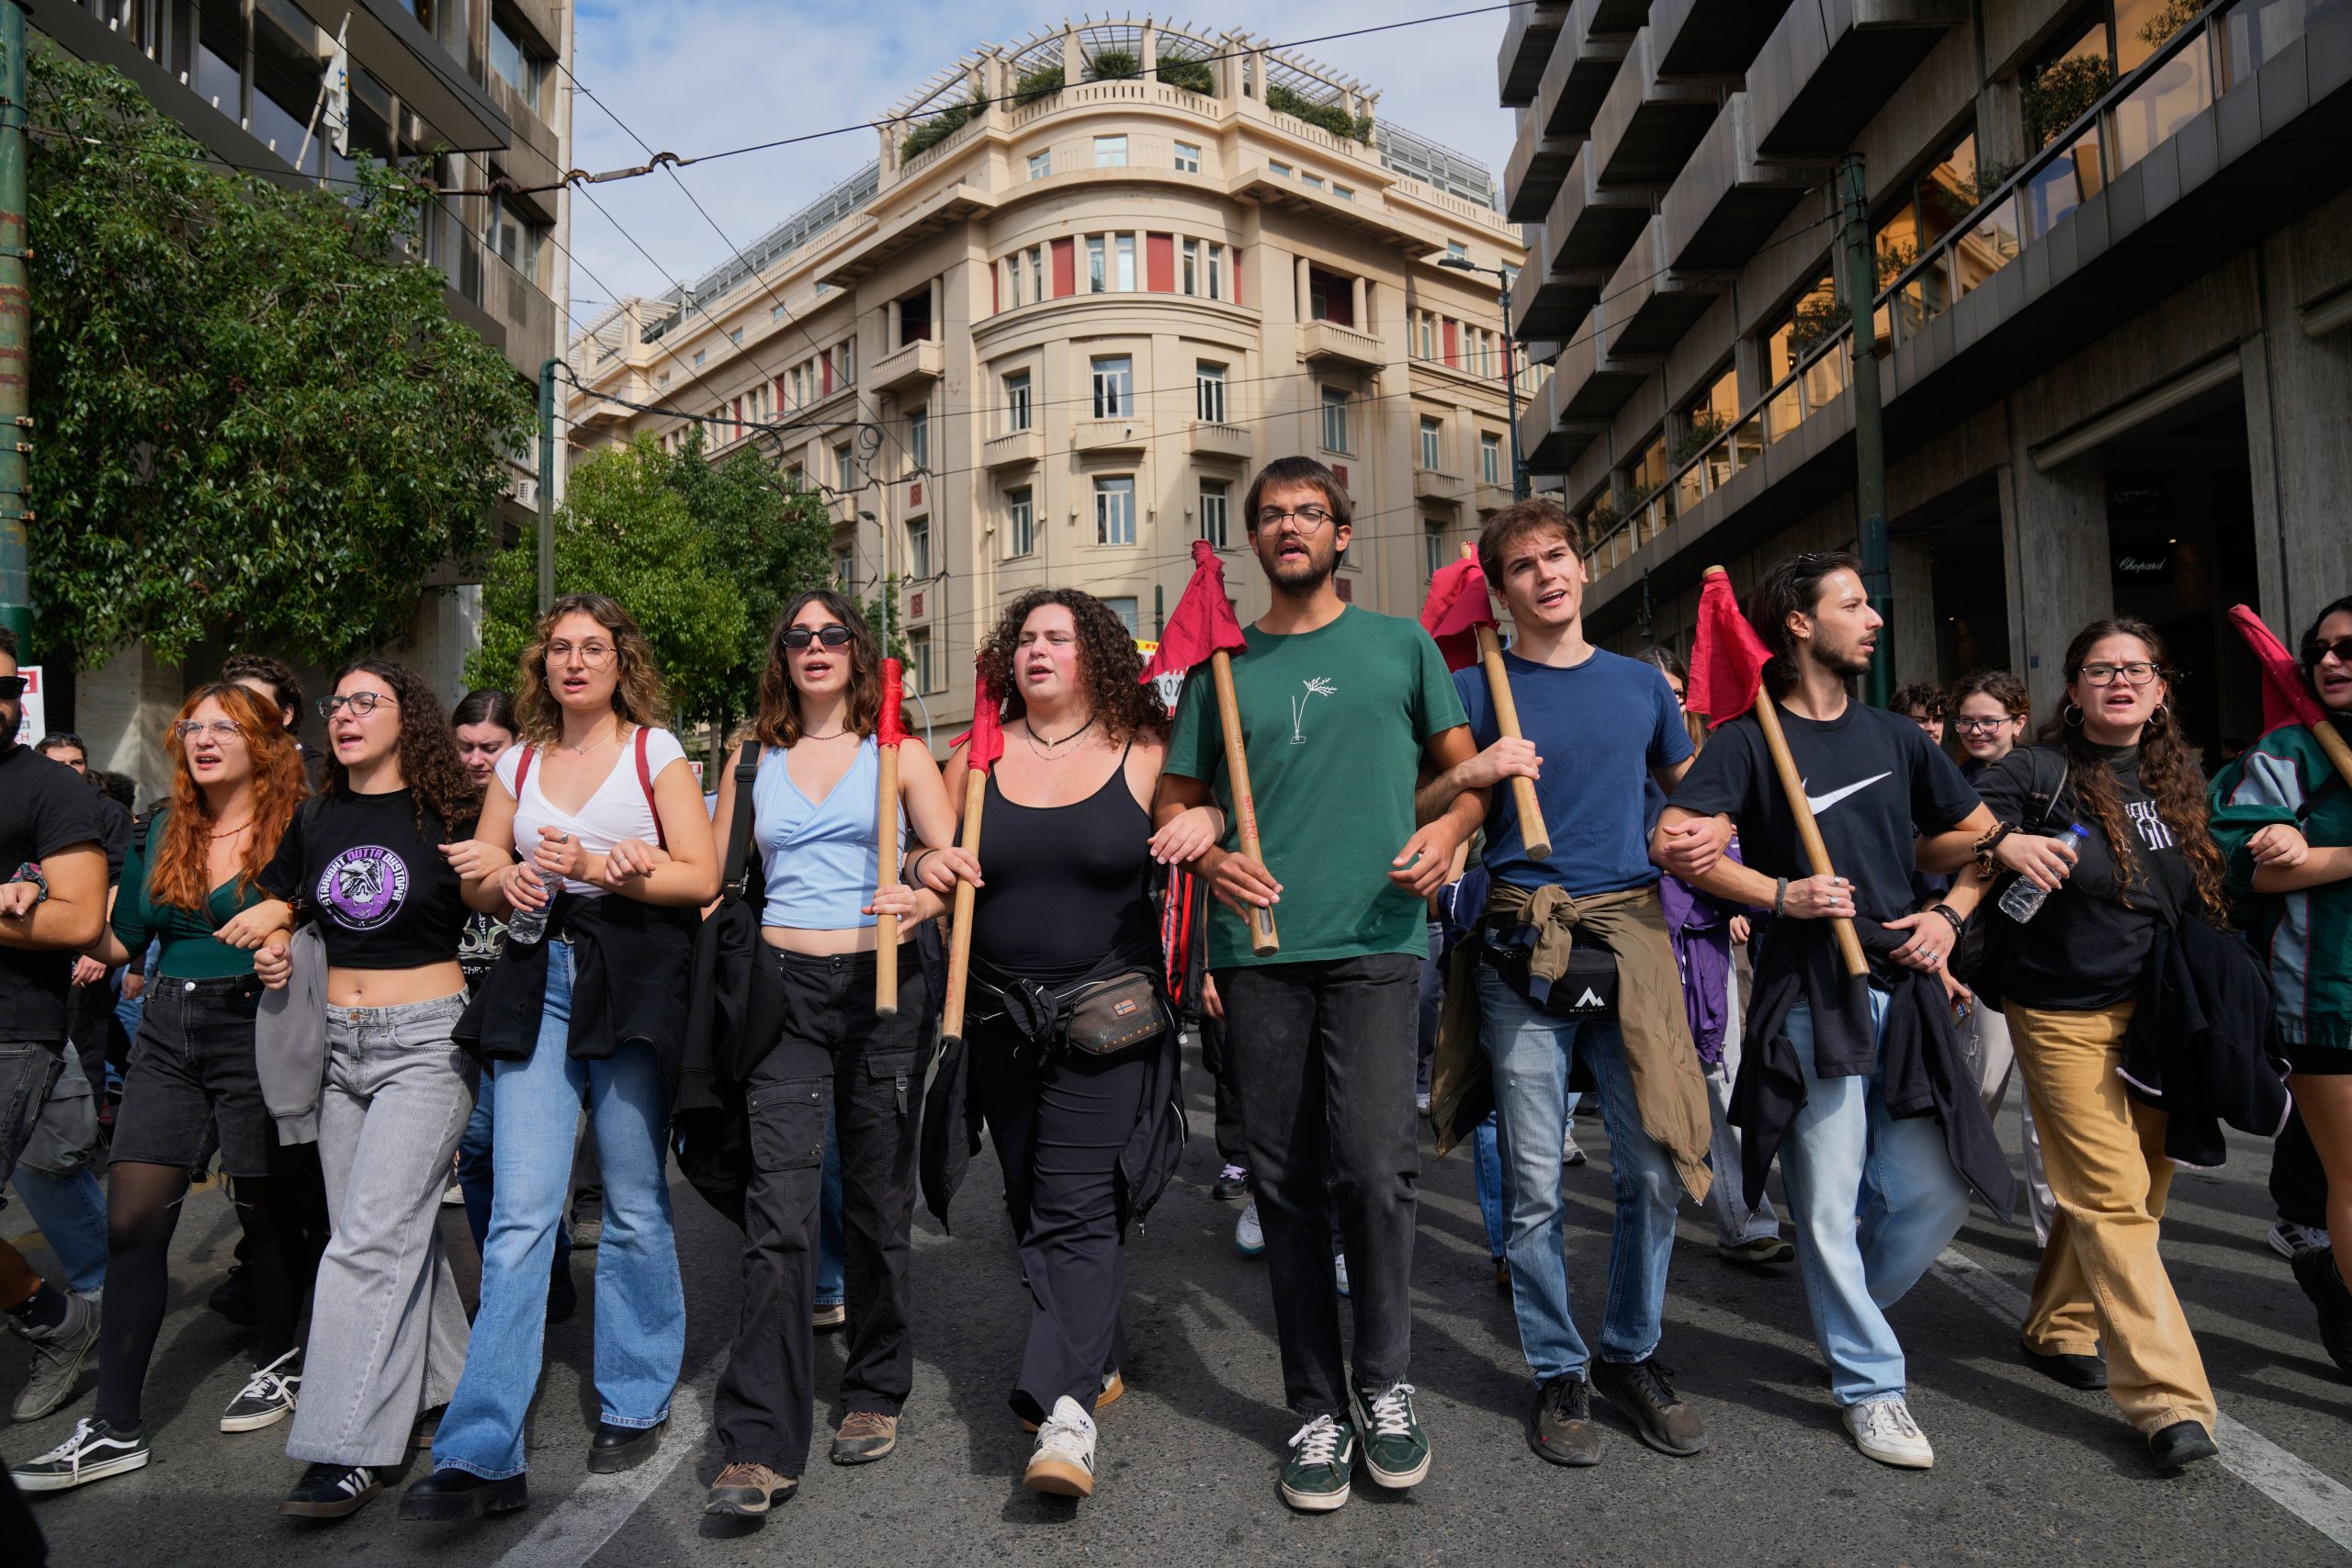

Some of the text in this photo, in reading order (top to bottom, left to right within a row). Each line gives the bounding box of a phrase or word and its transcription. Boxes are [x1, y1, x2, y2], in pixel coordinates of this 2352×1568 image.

[2115, 556, 2167, 573] Chopard
[319, 847, 406, 907] STRAIGHT OUTTA DYSTOPIA
